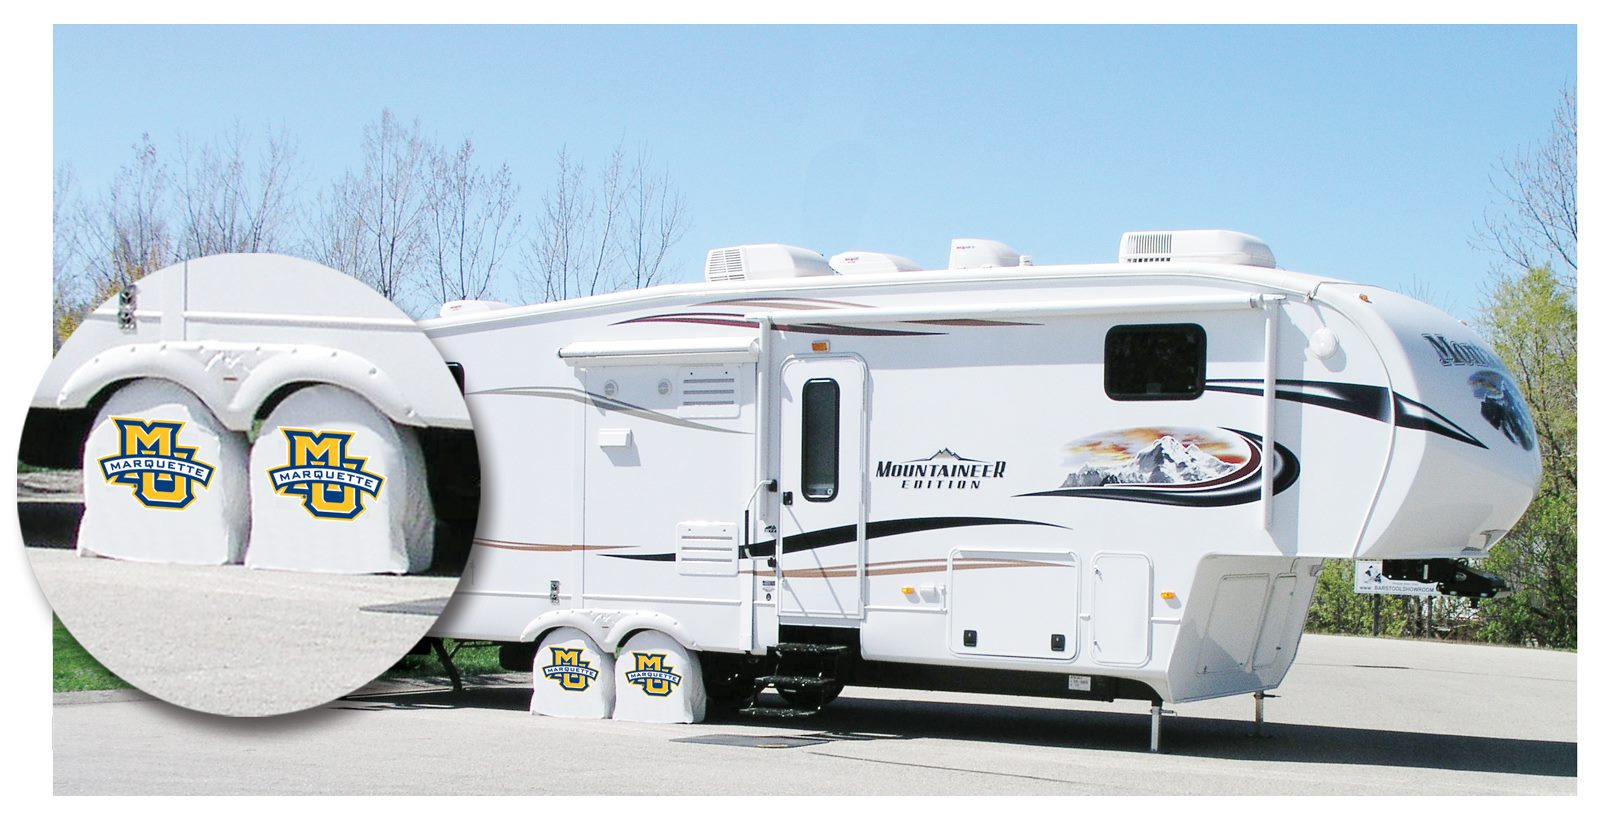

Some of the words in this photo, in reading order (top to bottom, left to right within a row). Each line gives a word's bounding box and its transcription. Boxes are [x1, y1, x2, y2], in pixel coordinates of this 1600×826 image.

[110, 459, 205, 478] MARQUETTE
[876, 460, 1007, 478] MOUNTAINEER
[279, 470, 374, 488] MARQUETTE
[901, 479, 981, 489] EDITION
[547, 666, 594, 677] MARQUETTE
[630, 671, 677, 683] MARQUETTE
